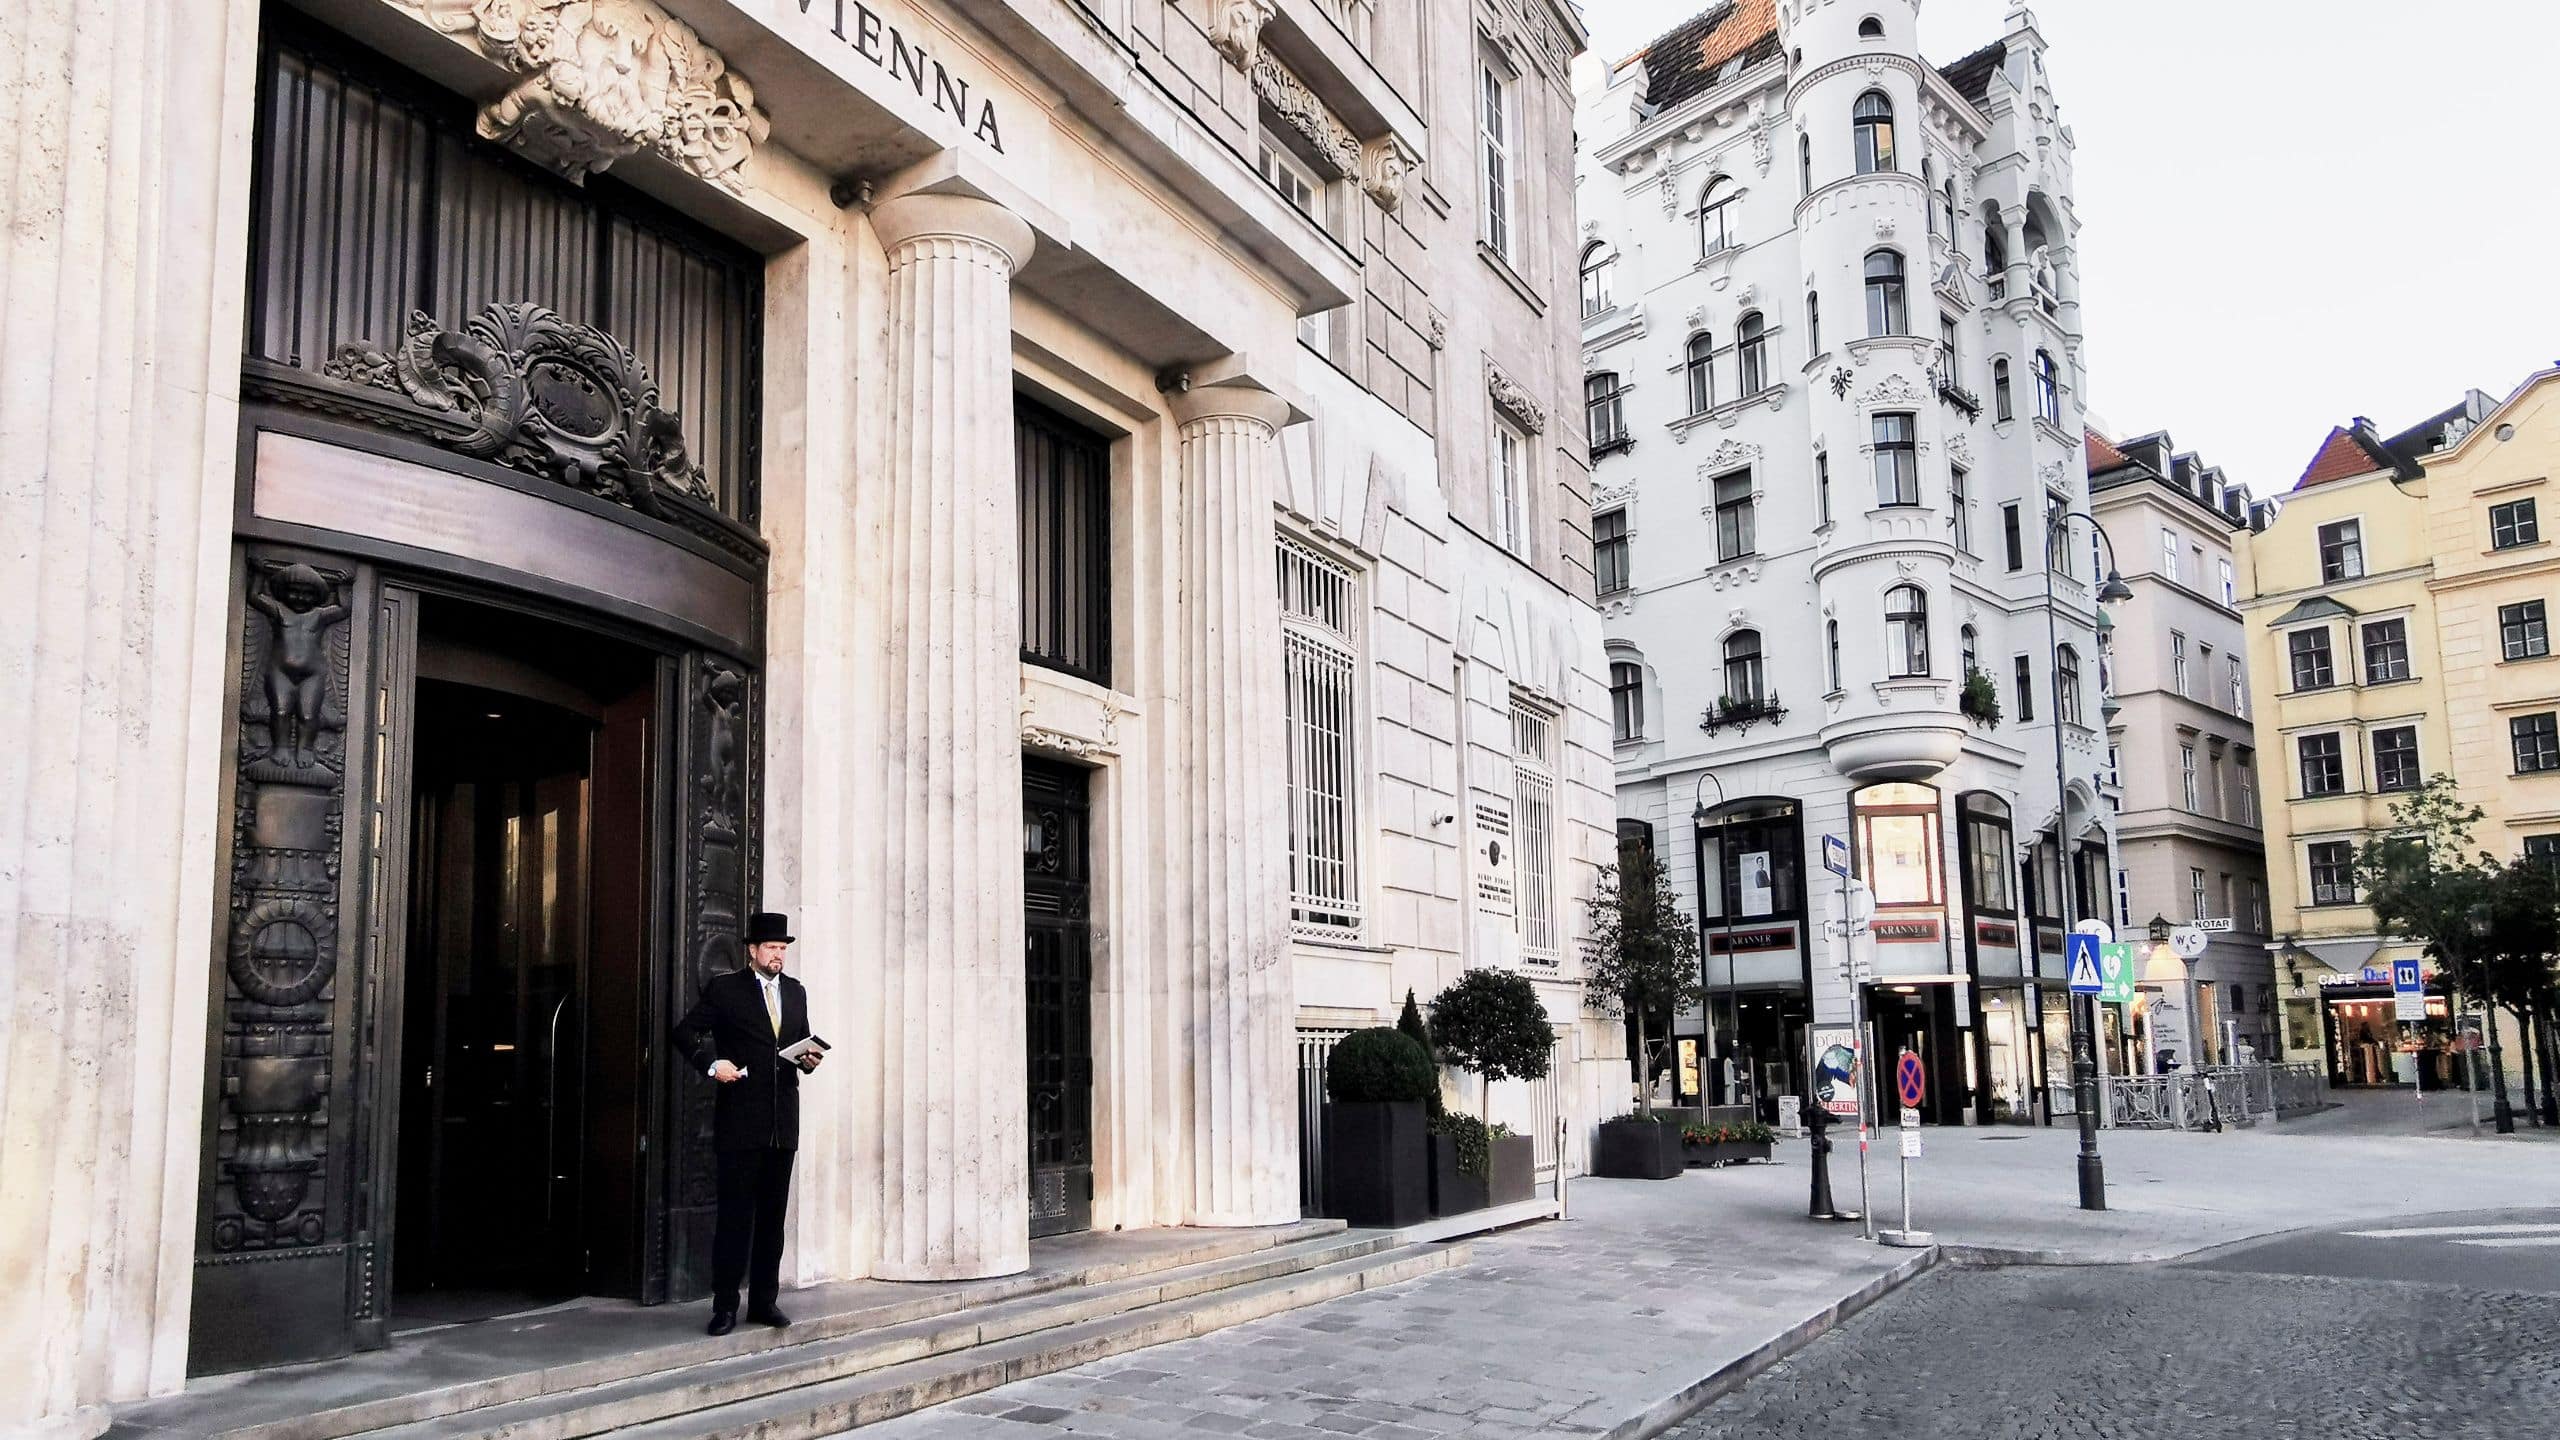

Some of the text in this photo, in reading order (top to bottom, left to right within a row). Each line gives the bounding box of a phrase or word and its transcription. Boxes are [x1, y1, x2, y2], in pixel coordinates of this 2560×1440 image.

[799, 0, 1004, 154] IENNA
[2195, 920, 2230, 928] NOTAR
[1880, 925, 1928, 935] KRANNER
[1820, 1102, 1858, 1112] LBERTIN
